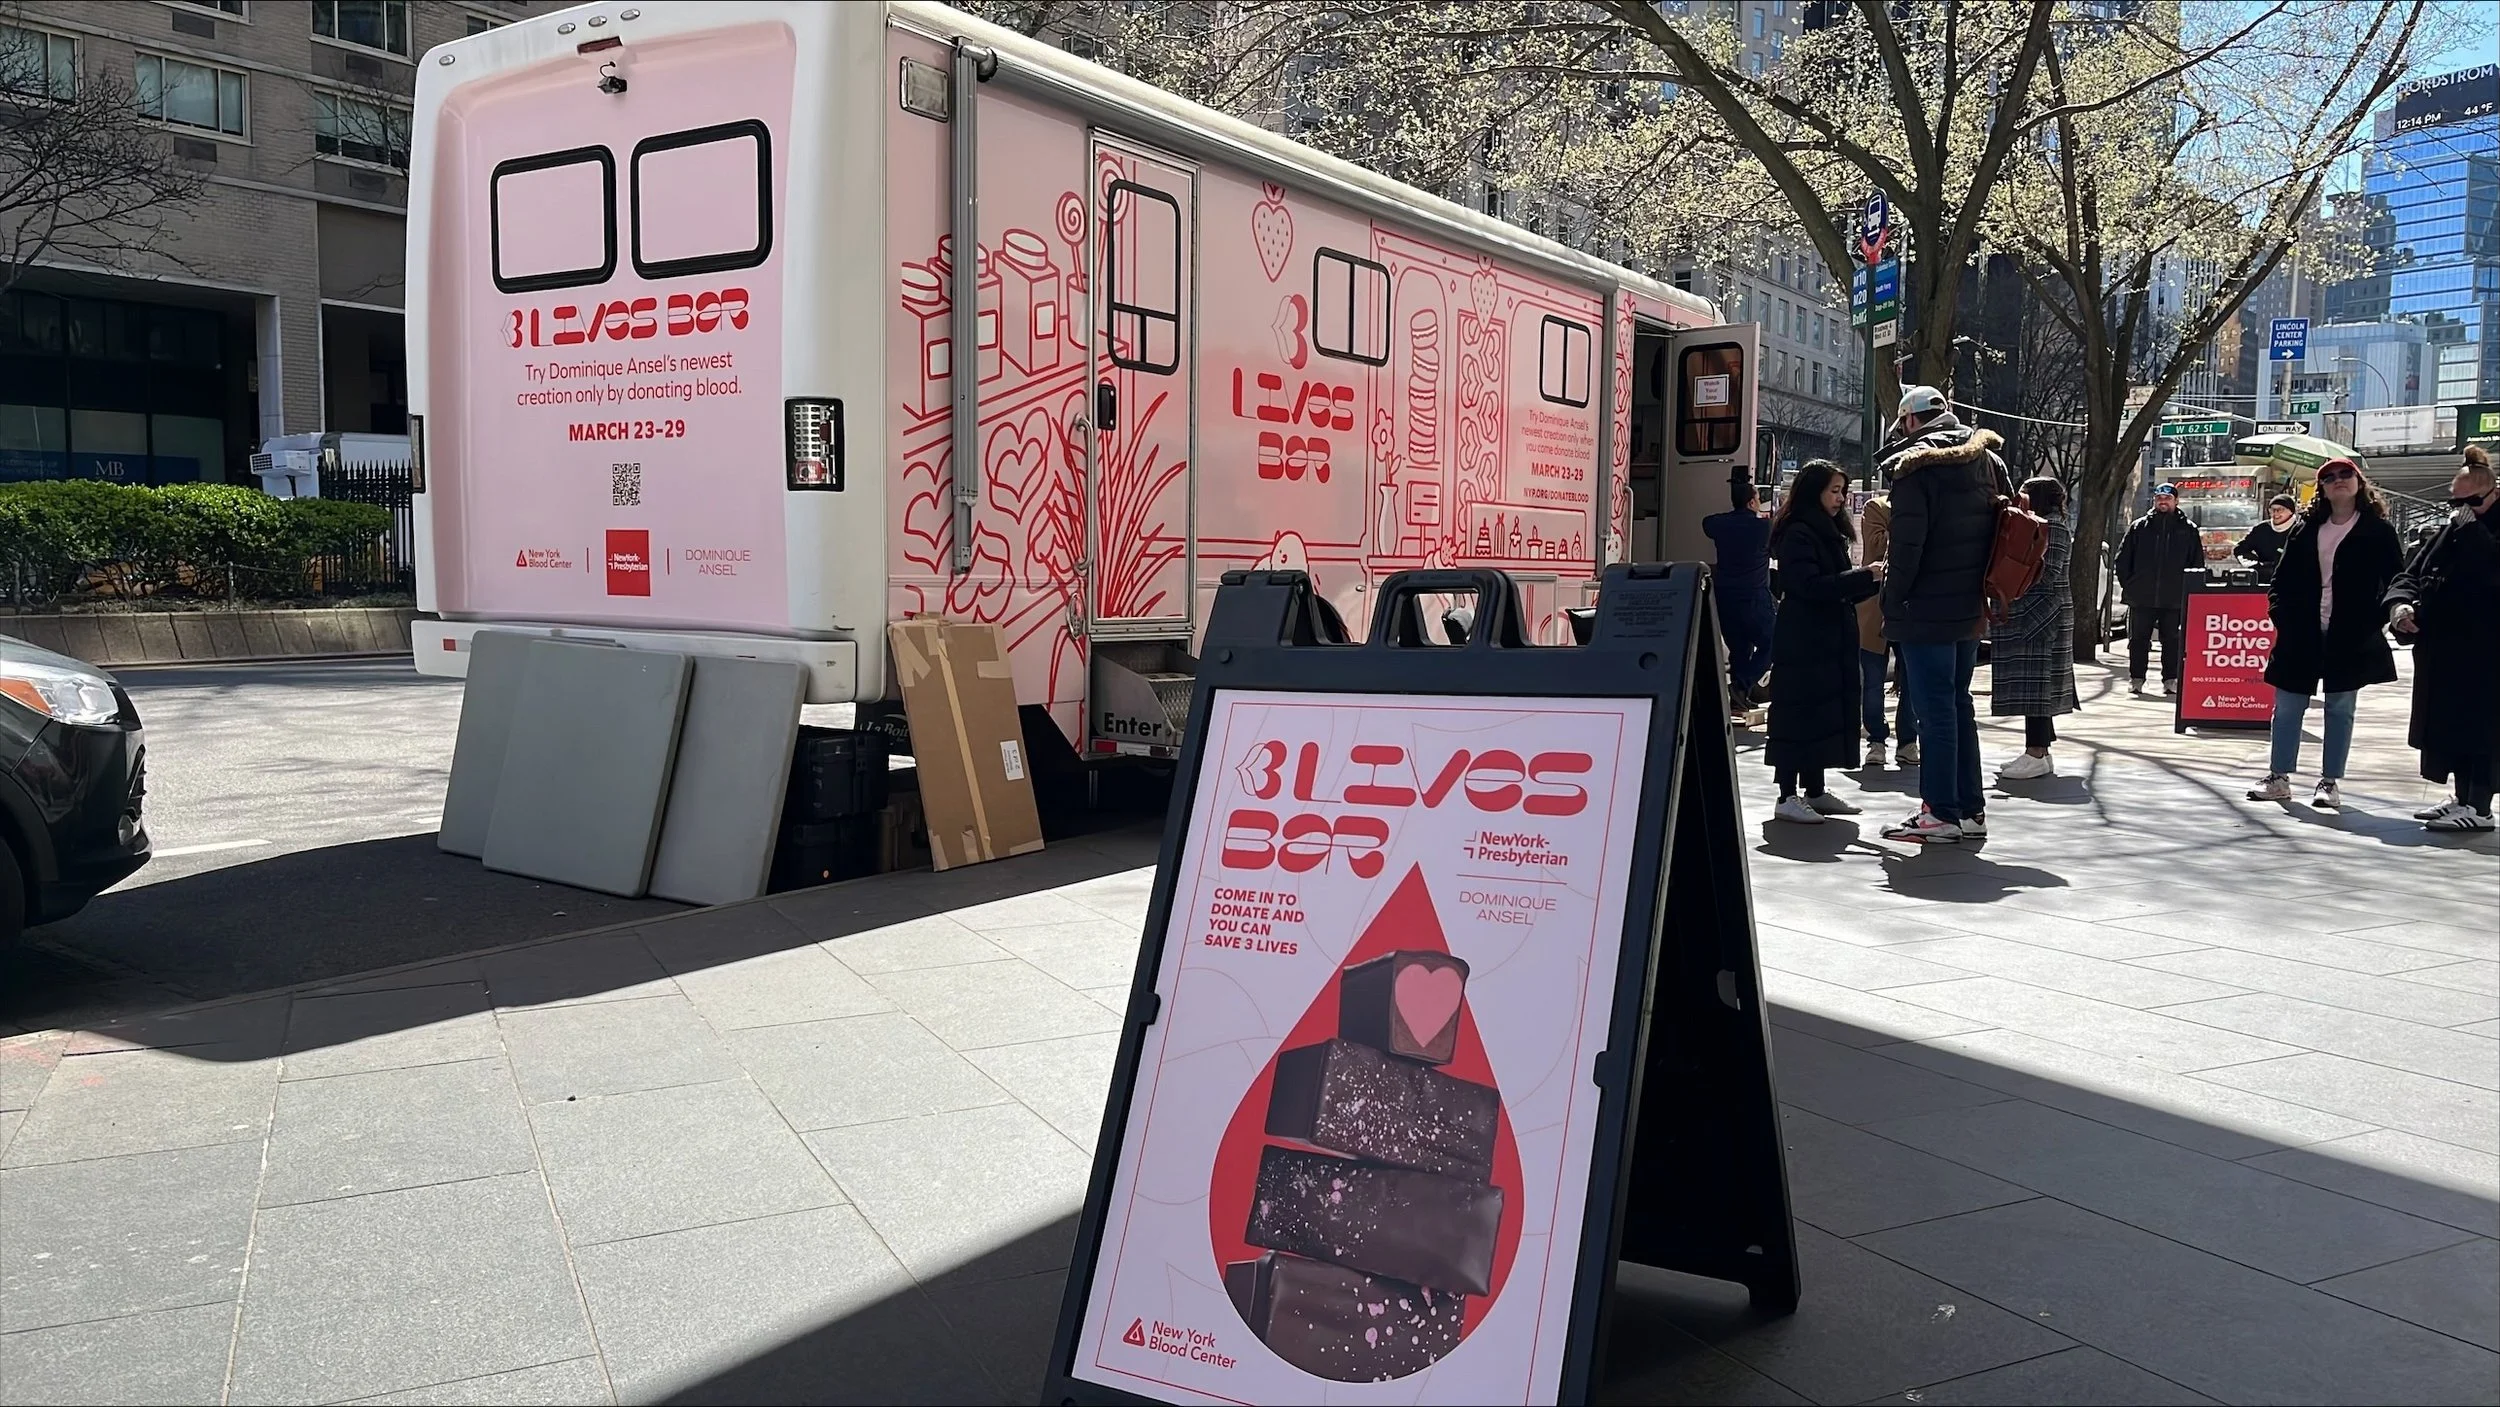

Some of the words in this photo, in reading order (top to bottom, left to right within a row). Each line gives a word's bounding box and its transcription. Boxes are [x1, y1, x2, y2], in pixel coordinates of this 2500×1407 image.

[2398, 64, 2494, 93] NORDSTROM
[2397, 116, 2422, 129] 12:14
[2425, 113, 2441, 124] PM
[2464, 105, 2479, 115] 44
[1853, 289, 1867, 306] M20
[500, 309, 523, 348] 3
[1271, 294, 1308, 370] 3
[2275, 322, 2305, 330] LINCOLN
[2276, 331, 2303, 339] CENTER
[2273, 339, 2304, 347] PARKING
[525, 364, 546, 384] Try
[549, 360, 623, 380] Dominique
[627, 354, 677, 375] Ansel's
[680, 352, 733, 371] newest
[517, 387, 572, 406] creation
[575, 385, 604, 406] only
[607, 384, 624, 404] by
[627, 380, 692, 401] donating
[697, 376, 742, 396] blood.
[2300, 403, 2310, 413] 62
[1529, 409, 1539, 425] Try
[1539, 411, 1569, 428] Dominique
[2482, 416, 2500, 428] TD
[569, 421, 629, 441] MARCH
[634, 419, 685, 439] 23-29
[1521, 426, 1543, 439] newest
[1543, 430, 1567, 441] creation
[1567, 433, 1580, 446] only
[1580, 436, 1594, 446] when
[2175, 425, 2184, 434] W
[2188, 424, 2199, 433] 62
[2203, 424, 2213, 432] St
[2262, 425, 2278, 433] ONE
[2285, 425, 2302, 433] WAY
[1525, 442, 1537, 453] you
[1537, 446, 1554, 456] come
[1554, 446, 1574, 458] donate
[95, 460, 125, 477] MB
[1531, 462, 1560, 478] MARCH
[1561, 466, 1584, 481] 23-29
[528, 549, 543, 558] New
[544, 549, 560, 558] York
[685, 549, 751, 562] DOMINIQUE
[528, 559, 548, 568] Blood
[550, 559, 572, 569] Center
[613, 562, 649, 572] Presbyterian
[699, 564, 737, 576] ANSEL
[2205, 614, 2274, 632] Blood
[2207, 632, 2270, 650] Drive
[2202, 650, 2269, 672] Today
[1104, 712, 1163, 738] Enter
[1235, 740, 1288, 800] 3
[1481, 831, 1550, 848] NewYork-
[1478, 846, 1568, 867] Presbyterian
[1214, 888, 1256, 902] COME
[1259, 891, 1274, 904] IN
[1278, 893, 1297, 906] TO
[1459, 890, 1557, 911] DOMINIQUE
[1211, 903, 1270, 920] DONATE
[1272, 909, 1305, 923] AND
[1476, 909, 1534, 926] ANSEL
[1209, 918, 1238, 932] YOU
[1241, 922, 1271, 936] CAN
[1204, 934, 1241, 949] SAVE
[1244, 938, 1253, 950] 3
[1256, 940, 1298, 955] LIVES
[1152, 1320, 1184, 1341] New
[1187, 1328, 1216, 1348] York
[1149, 1336, 1188, 1358] Blood
[1190, 1346, 1237, 1369] Center
